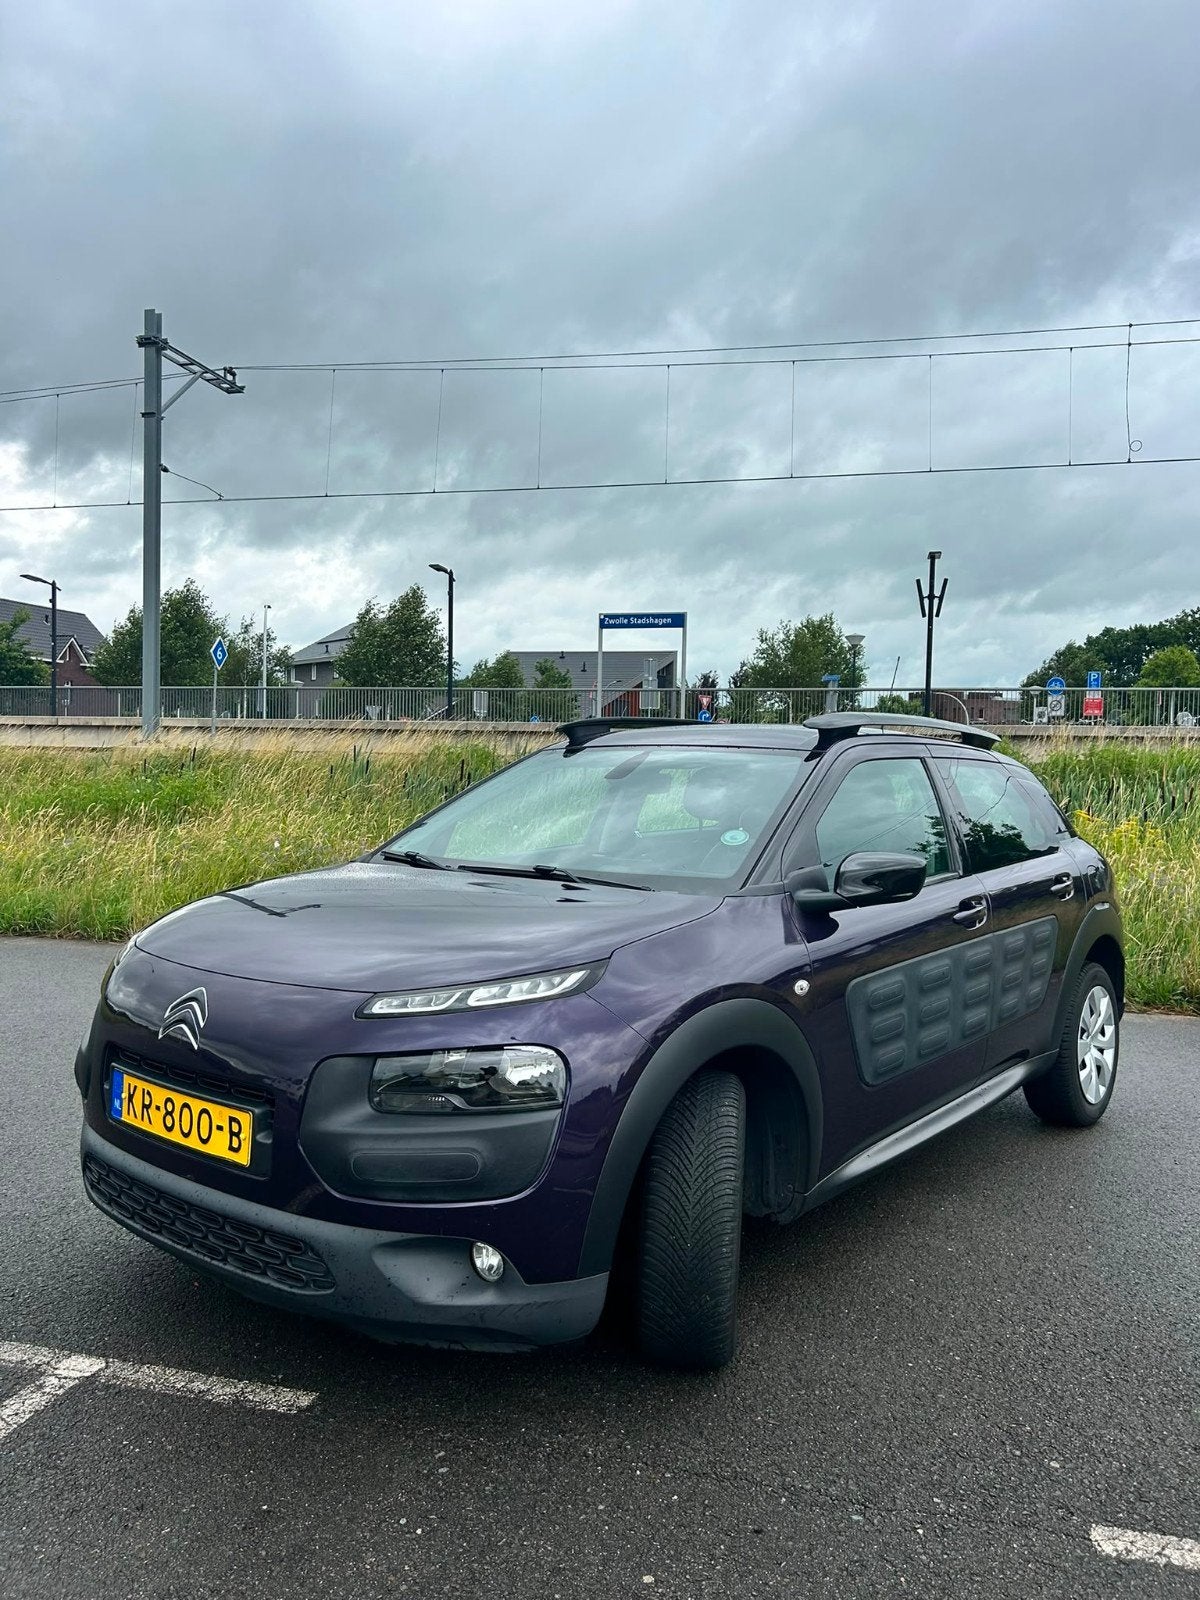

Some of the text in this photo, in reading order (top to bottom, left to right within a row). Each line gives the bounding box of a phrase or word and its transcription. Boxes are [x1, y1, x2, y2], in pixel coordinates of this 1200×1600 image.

[604, 616, 672, 626] Zwolle Stadshagen
[216, 647, 223, 660] 6
[1090, 673, 1098, 682] P
[113, 1097, 122, 1111] NL
[126, 1082, 243, 1154] KR-800-B
